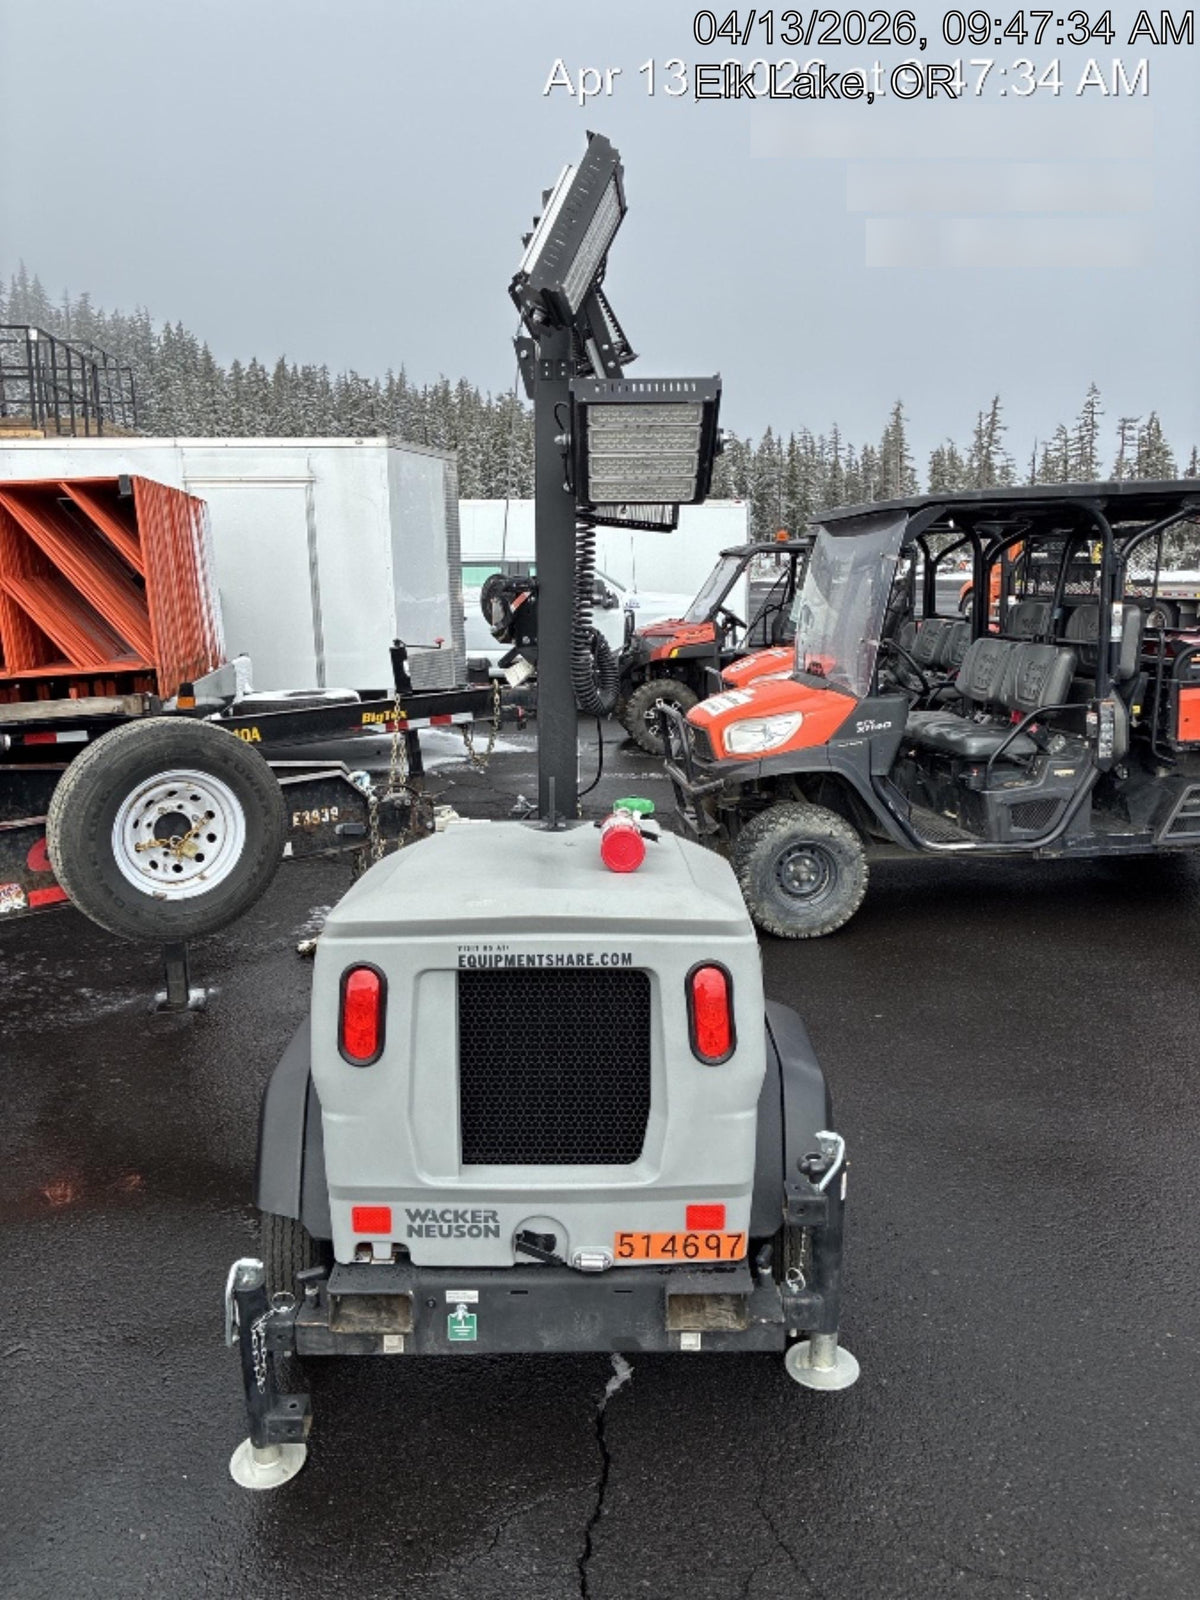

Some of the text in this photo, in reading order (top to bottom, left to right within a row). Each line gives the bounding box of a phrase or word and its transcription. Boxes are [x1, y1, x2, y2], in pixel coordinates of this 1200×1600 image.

[458, 953, 632, 968] EQUIPMENTSHARE.COM
[405, 1208, 500, 1224] WACKER
[407, 1224, 500, 1239] NEUSON
[618, 1233, 743, 1260] 514697
